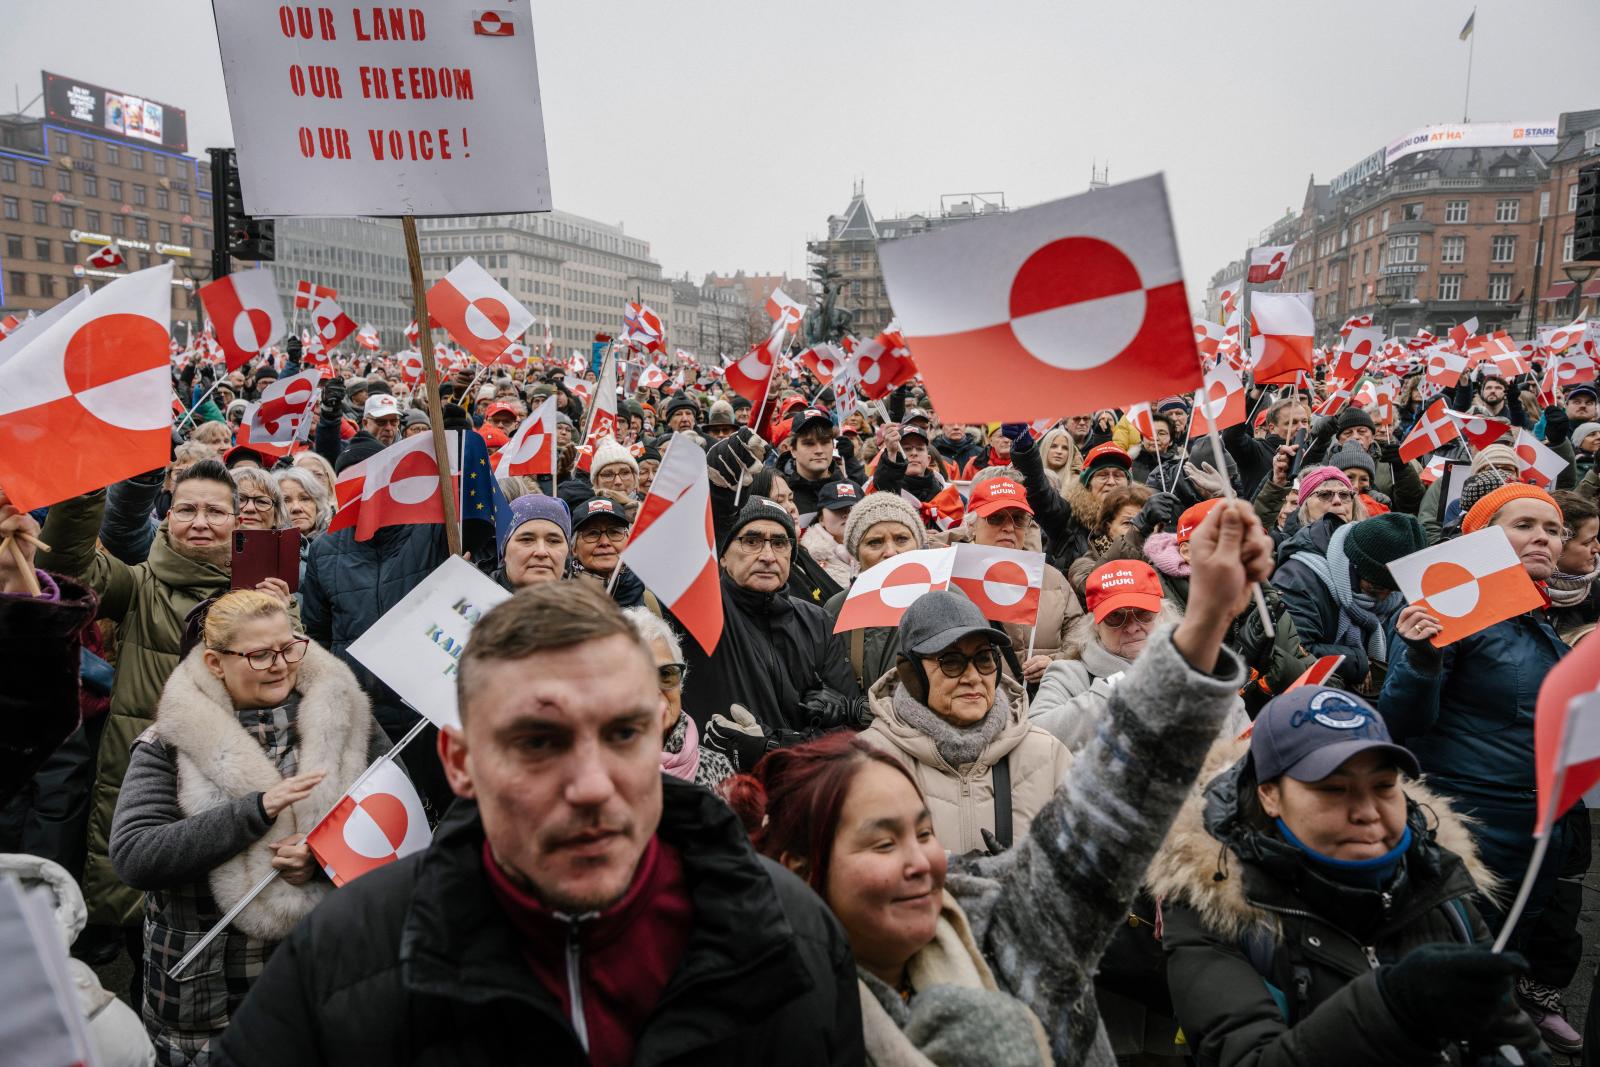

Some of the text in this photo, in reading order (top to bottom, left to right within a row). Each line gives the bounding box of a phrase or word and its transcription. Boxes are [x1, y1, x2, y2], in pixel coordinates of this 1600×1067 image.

[279, 6, 426, 41] OUR LAND
[289, 64, 474, 100] OUR FREEDOM
[1413, 134, 1429, 144] OM
[1431, 132, 1444, 141] AT
[1525, 128, 1556, 137] STARK
[298, 126, 351, 160] OUR
[1328, 146, 1386, 199] POLITIKEN
[991, 488, 1016, 496] NUUK!
[1101, 573, 1114, 581] Nu
[1101, 578, 1135, 590] NUUK!
